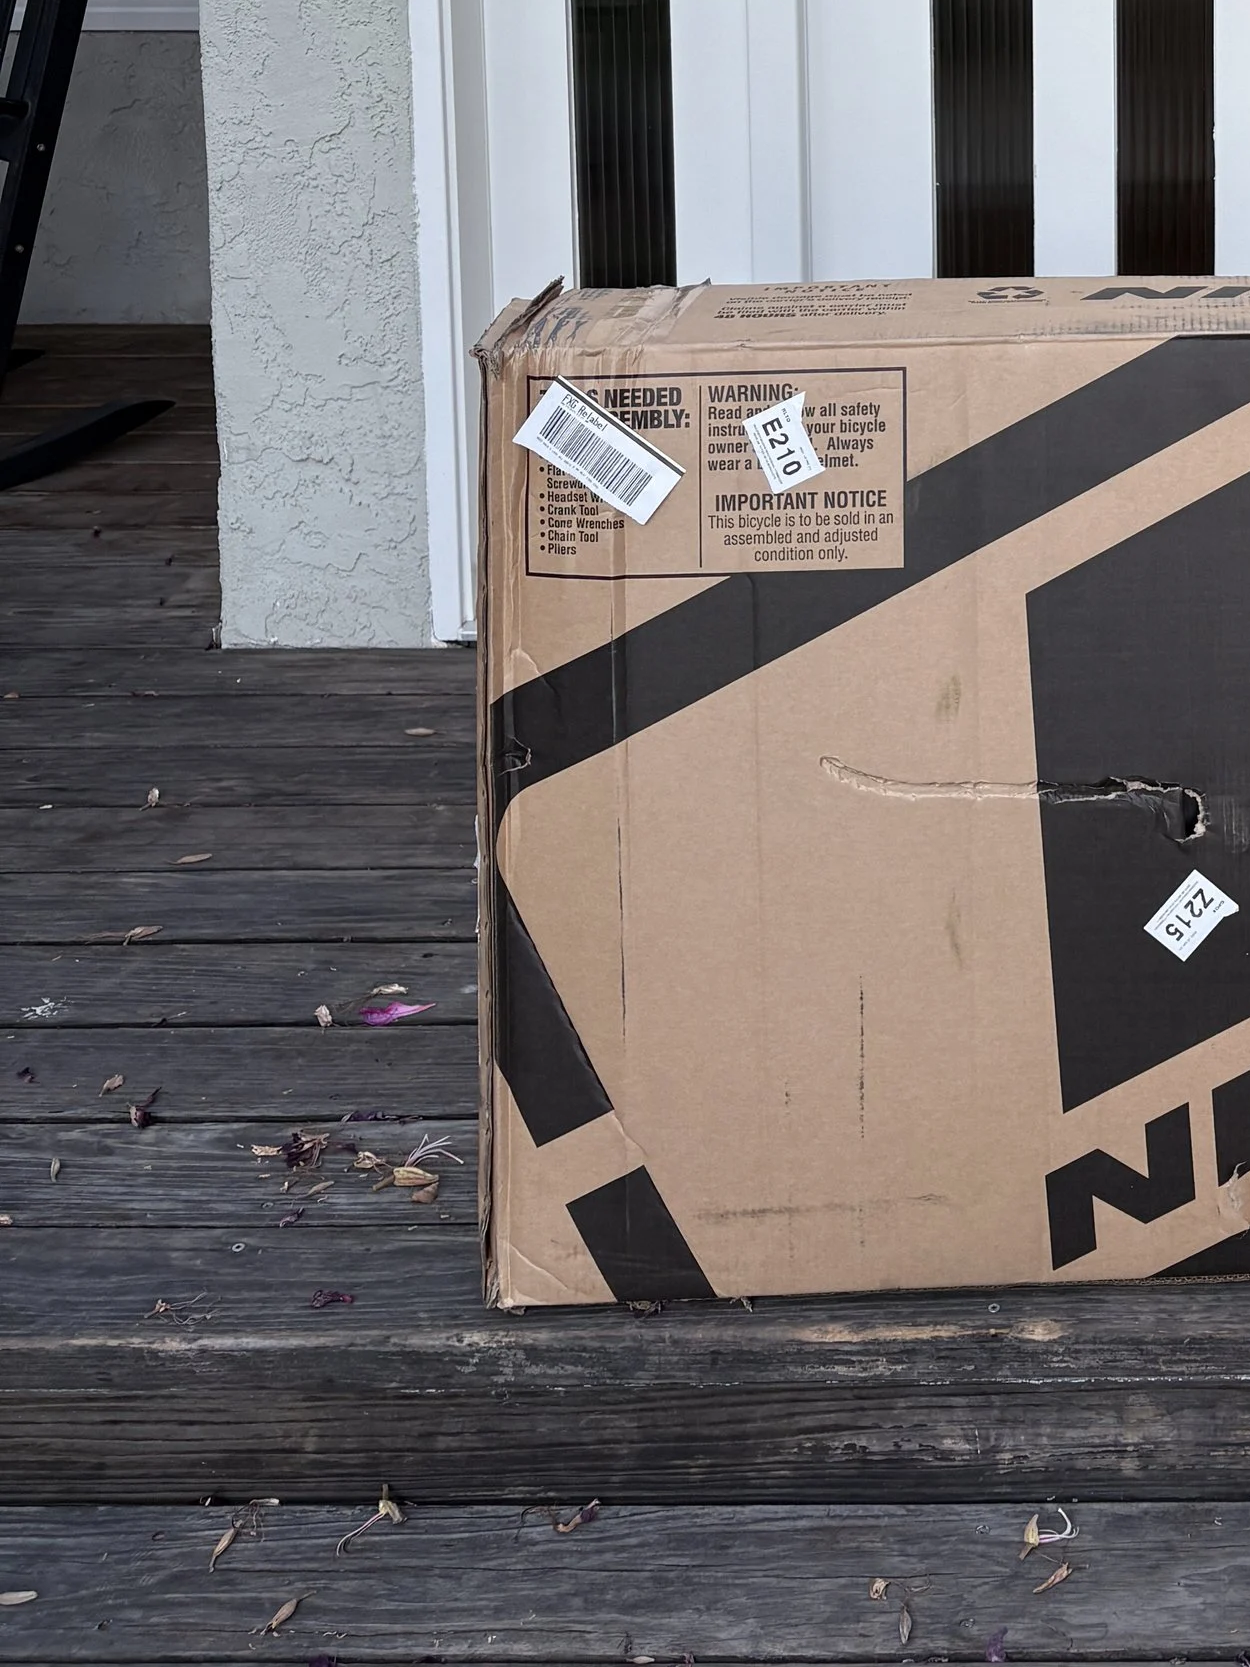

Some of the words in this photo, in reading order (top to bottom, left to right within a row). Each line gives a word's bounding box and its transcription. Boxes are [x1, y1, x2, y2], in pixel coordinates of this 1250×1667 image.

[604, 387, 683, 408] NEEDED
[708, 383, 799, 403] WARNING:
[578, 405, 609, 432] Relabel
[614, 408, 691, 430] EMBLY:
[708, 405, 742, 420] Read
[820, 403, 837, 417] all
[841, 402, 881, 418] safety
[807, 421, 836, 435] your
[840, 419, 887, 435] bicycle
[762, 417, 802, 476] E210
[827, 437, 874, 453] Always
[708, 459, 740, 471] wear
[744, 459, 752, 470] a
[819, 454, 859, 468] elmet.
[547, 491, 588, 503] Headset
[715, 492, 818, 512] IMPORTANT
[824, 490, 887, 509] NOTICE
[547, 504, 576, 515] Crank
[579, 505, 599, 516] Tool
[548, 517, 573, 528] Cone
[576, 518, 625, 530] Wrenches
[708, 515, 735, 529] This
[738, 513, 781, 531] bicycle
[785, 513, 796, 527] is
[799, 513, 812, 527] to
[815, 512, 831, 526] be
[834, 511, 860, 525] sold
[864, 511, 875, 524] in
[879, 512, 894, 524] an
[548, 530, 576, 542] Chain
[579, 530, 599, 543] Tool
[723, 530, 792, 546] assembled
[796, 529, 820, 544] and
[824, 527, 878, 546] adjusted
[548, 543, 577, 555] Pliers
[754, 546, 814, 562] condition
[818, 545, 848, 563] only.
[1165, 888, 1215, 942] Z215
